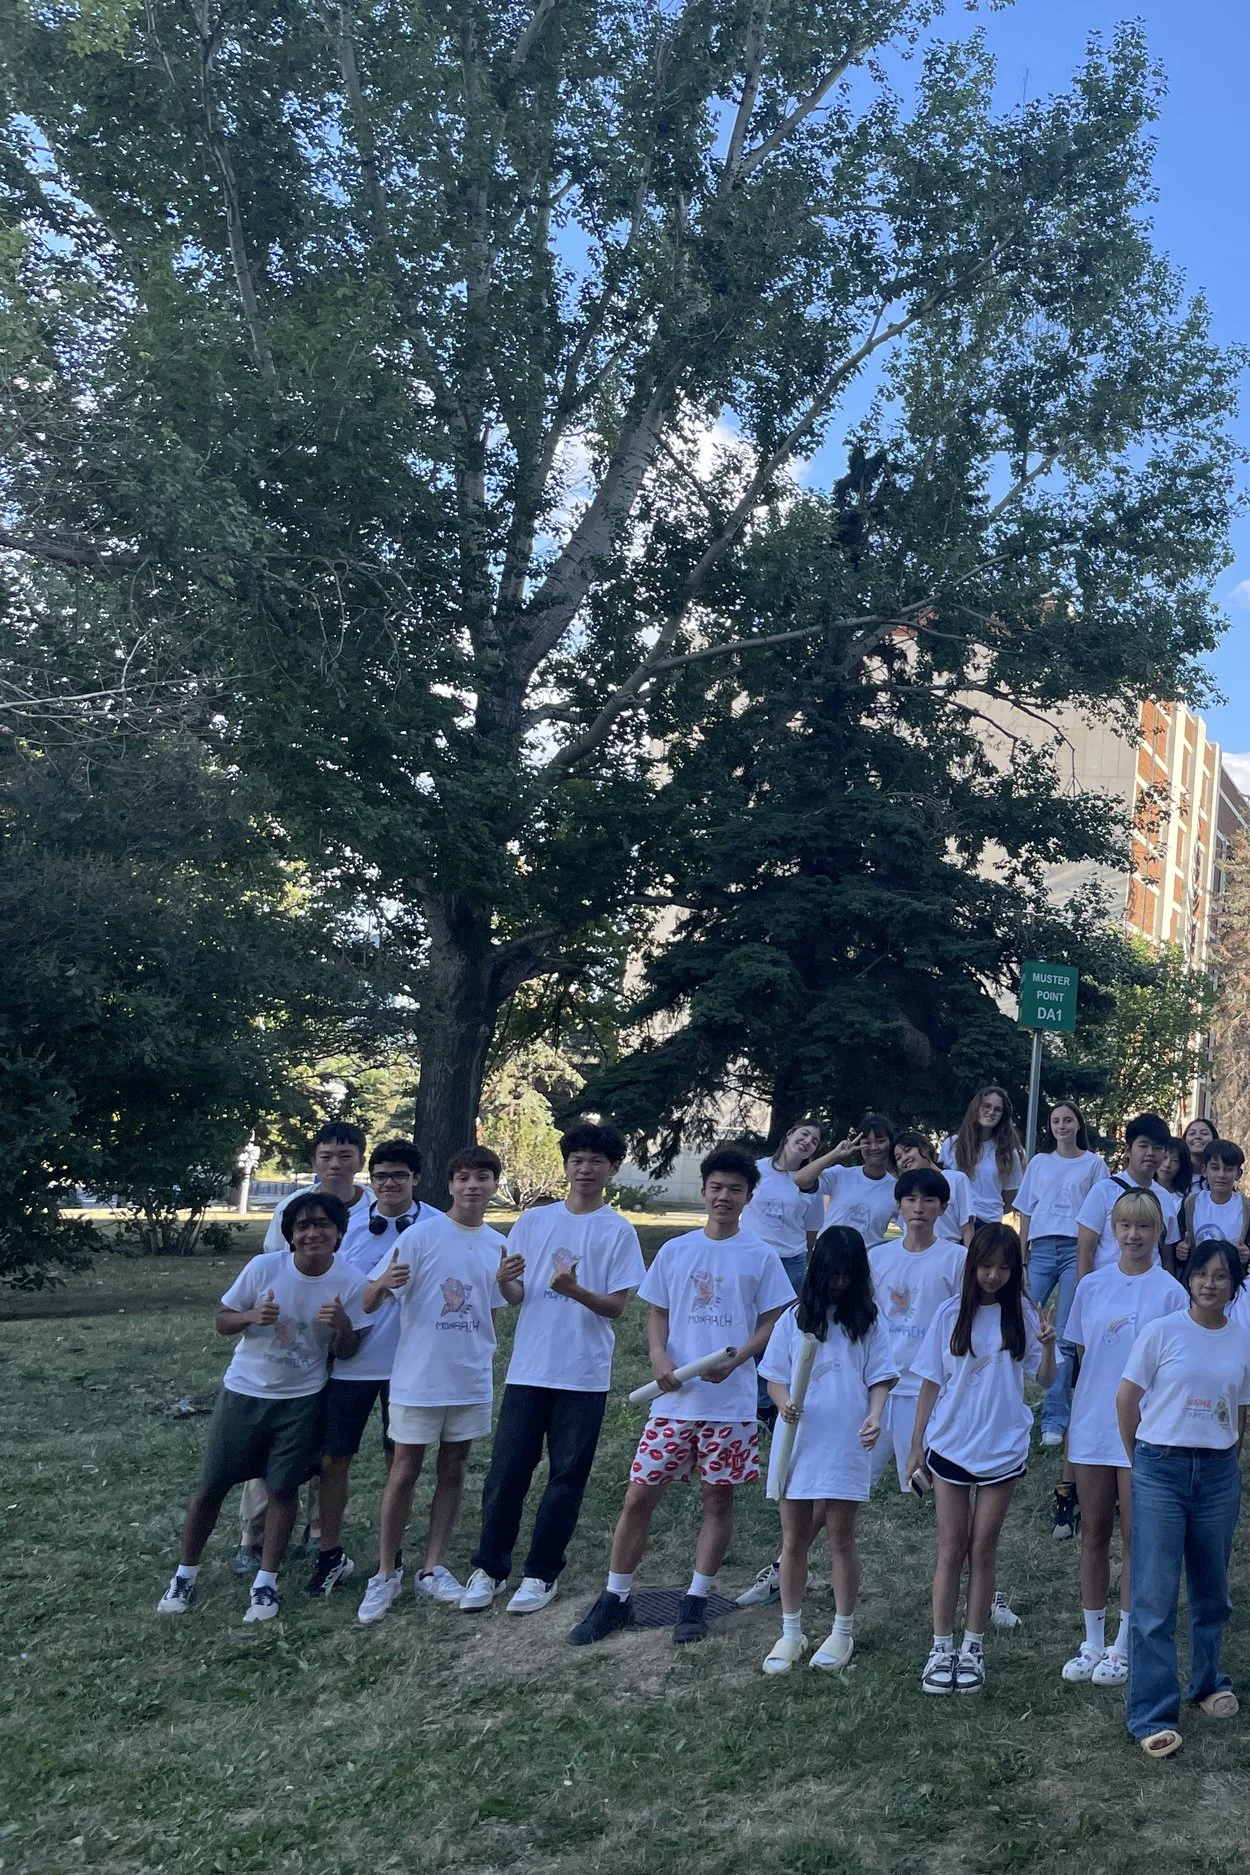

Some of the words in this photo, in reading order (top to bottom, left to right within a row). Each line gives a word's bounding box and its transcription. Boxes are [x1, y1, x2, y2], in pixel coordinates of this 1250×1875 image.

[1032, 972, 1071, 986] MUSTER
[1036, 990, 1065, 1002] POINT
[1037, 1006, 1063, 1021] DA1
[435, 1320, 480, 1333] MONARCH
[688, 1313, 733, 1328] MONARCH
